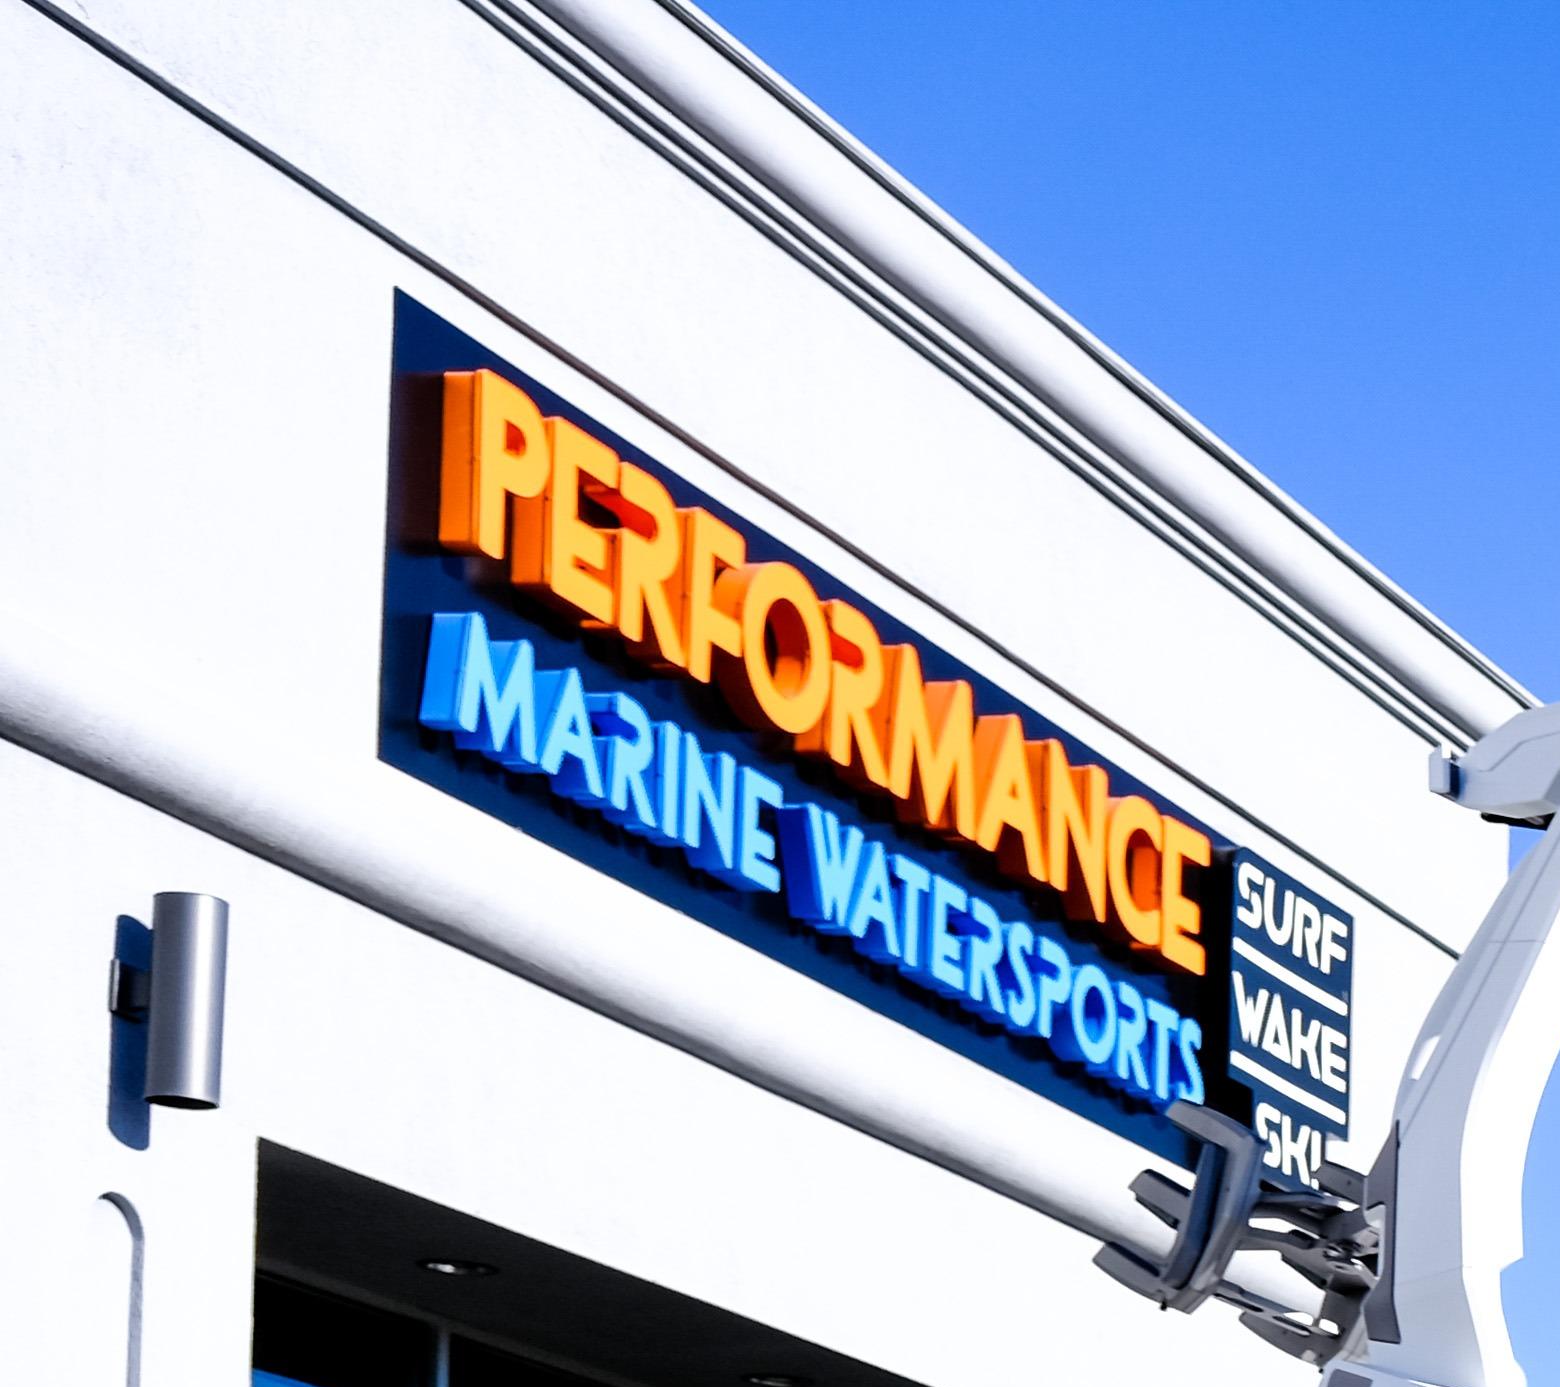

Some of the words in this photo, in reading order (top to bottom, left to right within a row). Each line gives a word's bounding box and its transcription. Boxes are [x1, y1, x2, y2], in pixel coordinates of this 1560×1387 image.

[441, 368, 1212, 976] PERFORMANCE
[420, 611, 785, 894] MARINE
[784, 801, 1205, 1106] WATERSPORTS
[1236, 861, 1349, 975] SURF
[1231, 970, 1348, 1094] WAKE
